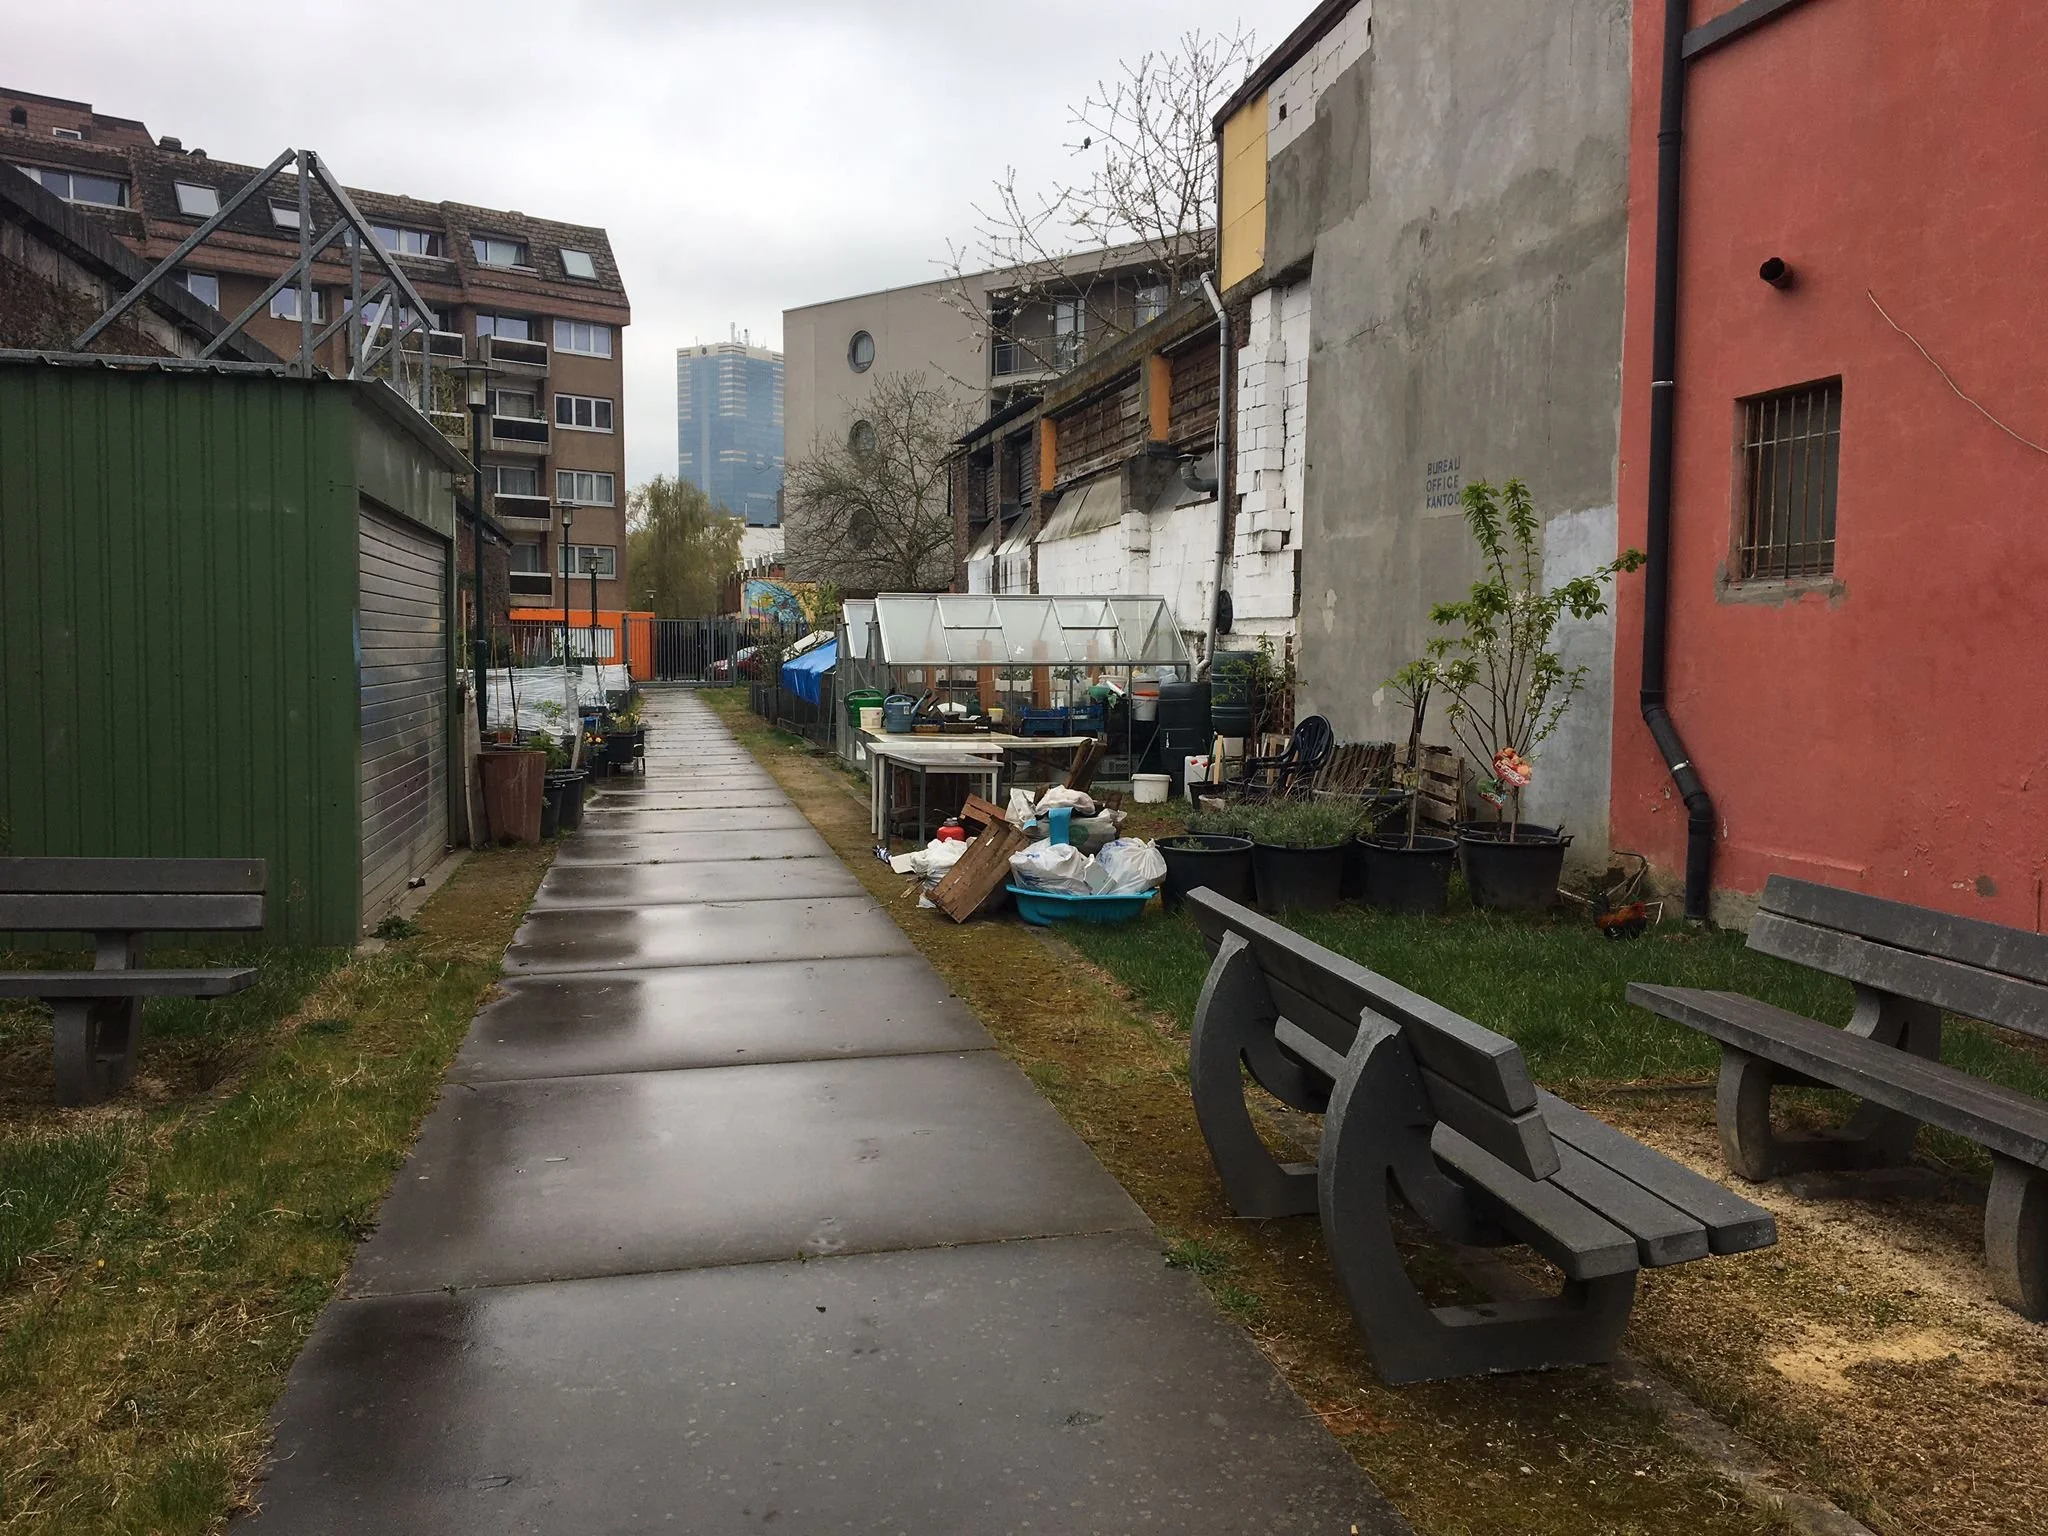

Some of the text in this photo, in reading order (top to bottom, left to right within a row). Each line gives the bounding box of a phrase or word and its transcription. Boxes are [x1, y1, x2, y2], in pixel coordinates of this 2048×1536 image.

[1427, 456, 1461, 476] BUREAU
[1426, 475, 1459, 492] OFFICE
[1426, 492, 1462, 509] KANTOO
